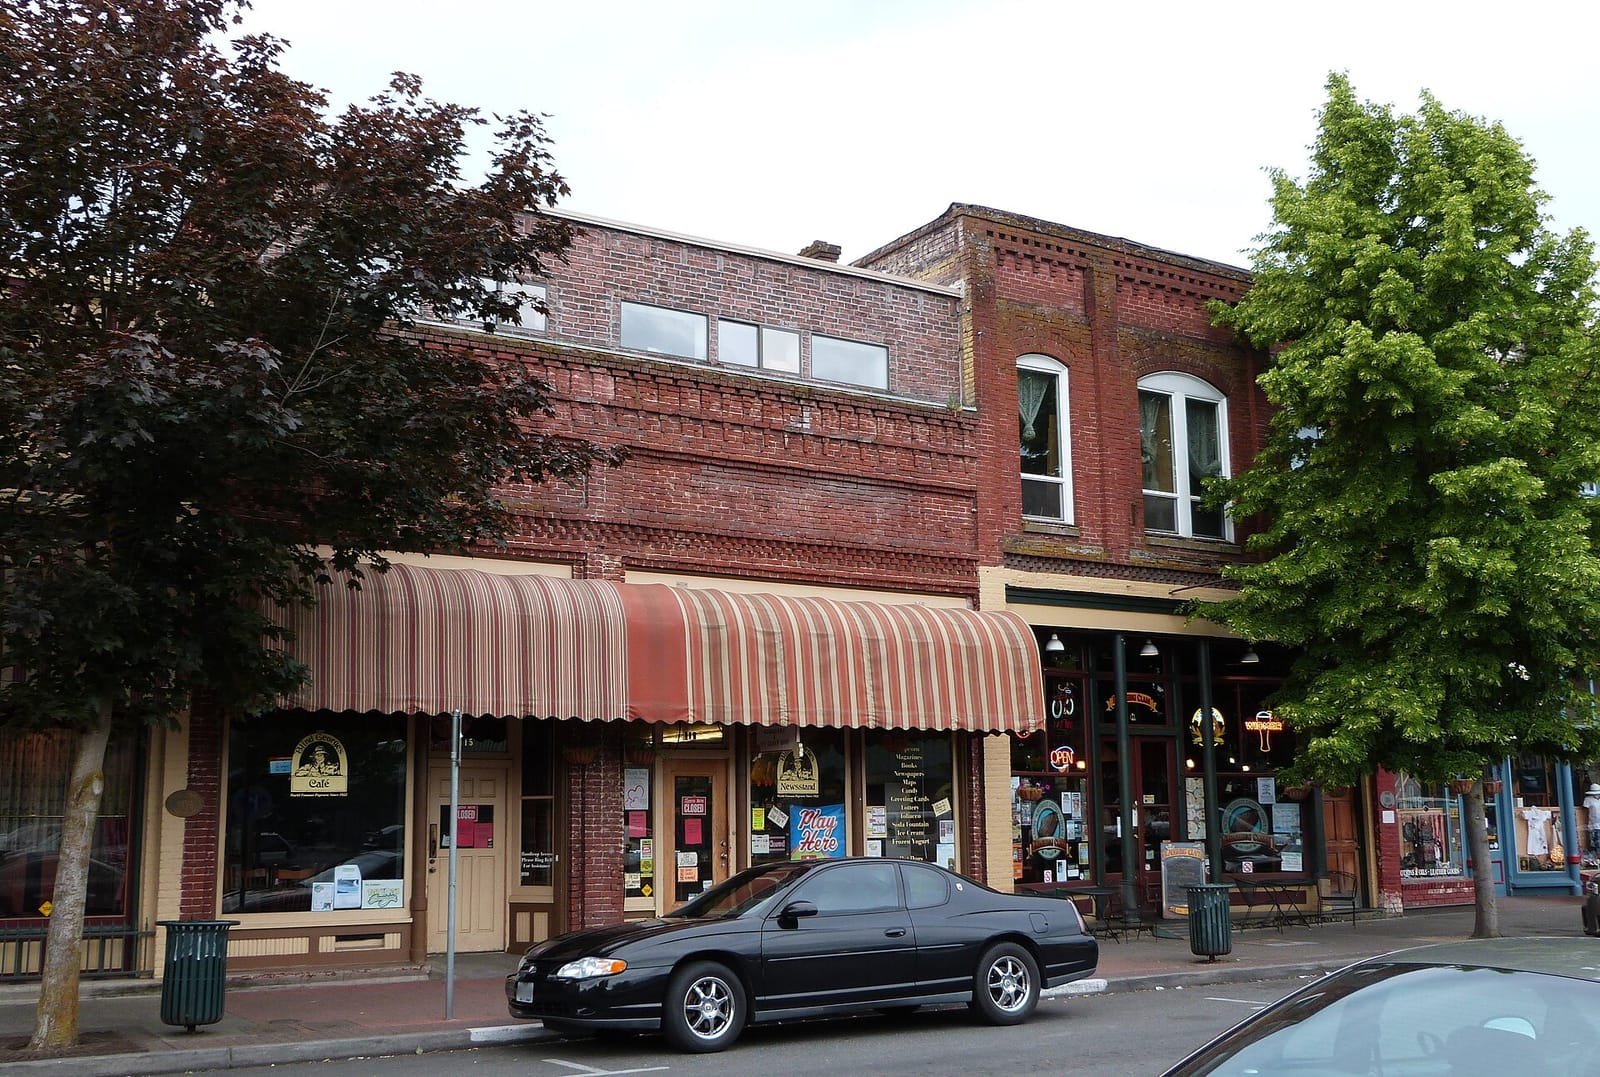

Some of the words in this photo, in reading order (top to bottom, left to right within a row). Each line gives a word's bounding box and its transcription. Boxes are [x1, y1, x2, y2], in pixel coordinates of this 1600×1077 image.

[1050, 750, 1074, 765] OPEN
[894, 770, 925, 778] Newspapers
[309, 778, 330, 789] Café
[780, 782, 816, 791] Newsstand
[901, 787, 918, 795] Candy
[683, 803, 705, 813] CLOSED
[457, 809, 476, 820] LOSED
[798, 809, 837, 838] Play
[799, 829, 838, 852] Here
[911, 838, 930, 846] Yogurt
